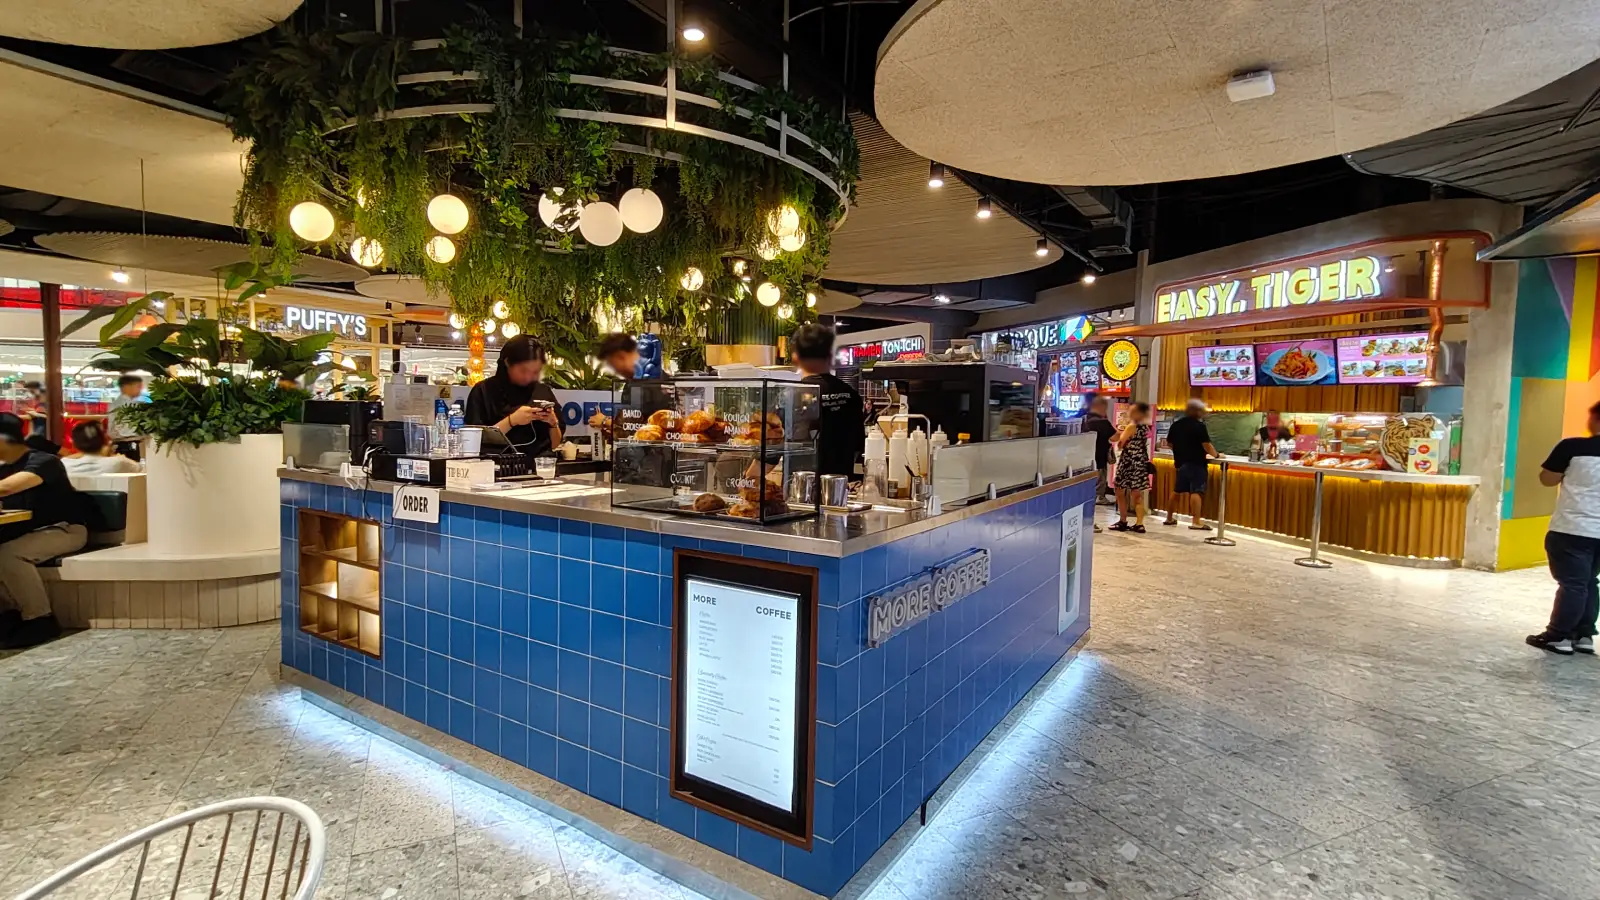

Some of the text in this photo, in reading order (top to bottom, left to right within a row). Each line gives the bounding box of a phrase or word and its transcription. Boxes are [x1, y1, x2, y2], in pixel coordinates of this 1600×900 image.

[1251, 256, 1382, 309] TIGER
[286, 306, 367, 336] PUFFY'S
[457, 467, 470, 479] BOX
[402, 494, 429, 513] ORDER
[693, 593, 717, 606] MORE
[873, 557, 990, 640] MORE COFFEE
[755, 605, 792, 620] COFFEE
